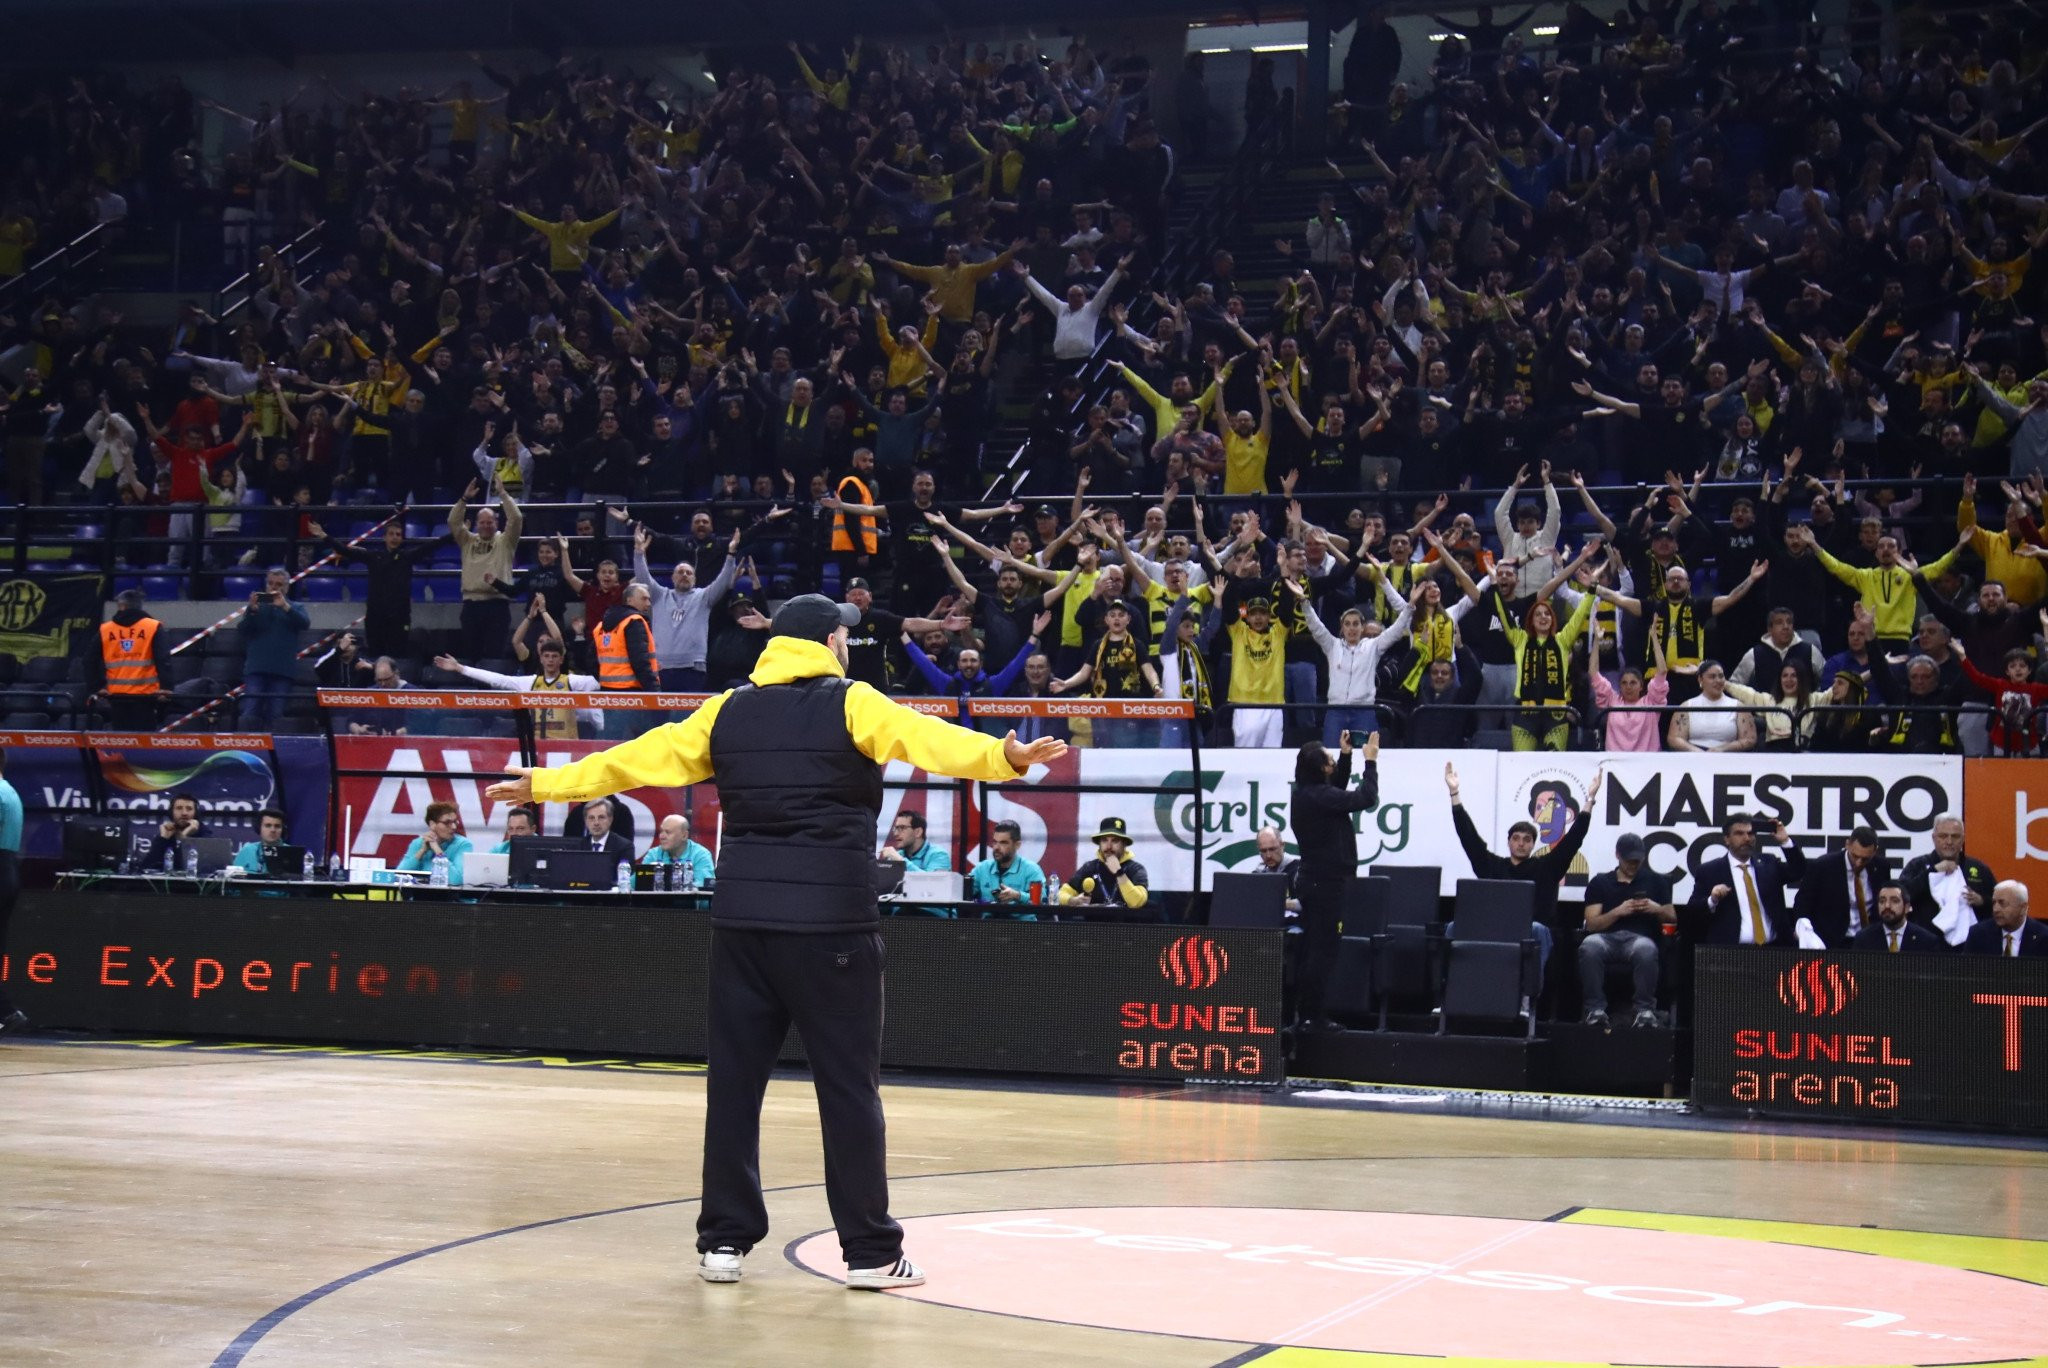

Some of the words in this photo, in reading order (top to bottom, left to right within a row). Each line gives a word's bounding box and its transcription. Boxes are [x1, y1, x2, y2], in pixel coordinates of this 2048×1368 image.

[108, 629, 146, 641] ALFA
[321, 693, 375, 705] betsson
[388, 694, 442, 706] betsson
[455, 694, 510, 706] betsson
[520, 694, 575, 706] betsson
[588, 695, 643, 707] betsson
[657, 695, 704, 707] betsso
[900, 701, 948, 713] tsson
[973, 702, 1031, 714] betsson
[1047, 702, 1107, 715] betsson
[1123, 703, 1183, 716] betsson
[24, 734, 76, 746] betsson
[89, 735, 139, 747] betsson
[150, 735, 201, 747] betsson
[213, 736, 265, 748] betsson
[876, 758, 1049, 867] IS
[1153, 770, 1414, 852] Carlsrg
[1605, 771, 1950, 833] MAESTRO
[100, 945, 524, 999] Experien
[1119, 1001, 1275, 1034] SUNEL
[1118, 1040, 1264, 1075] arena
[1734, 1029, 1913, 1067] SUNEL
[1732, 1069, 1900, 1110] arena
[944, 1217, 1906, 1329] betsson
